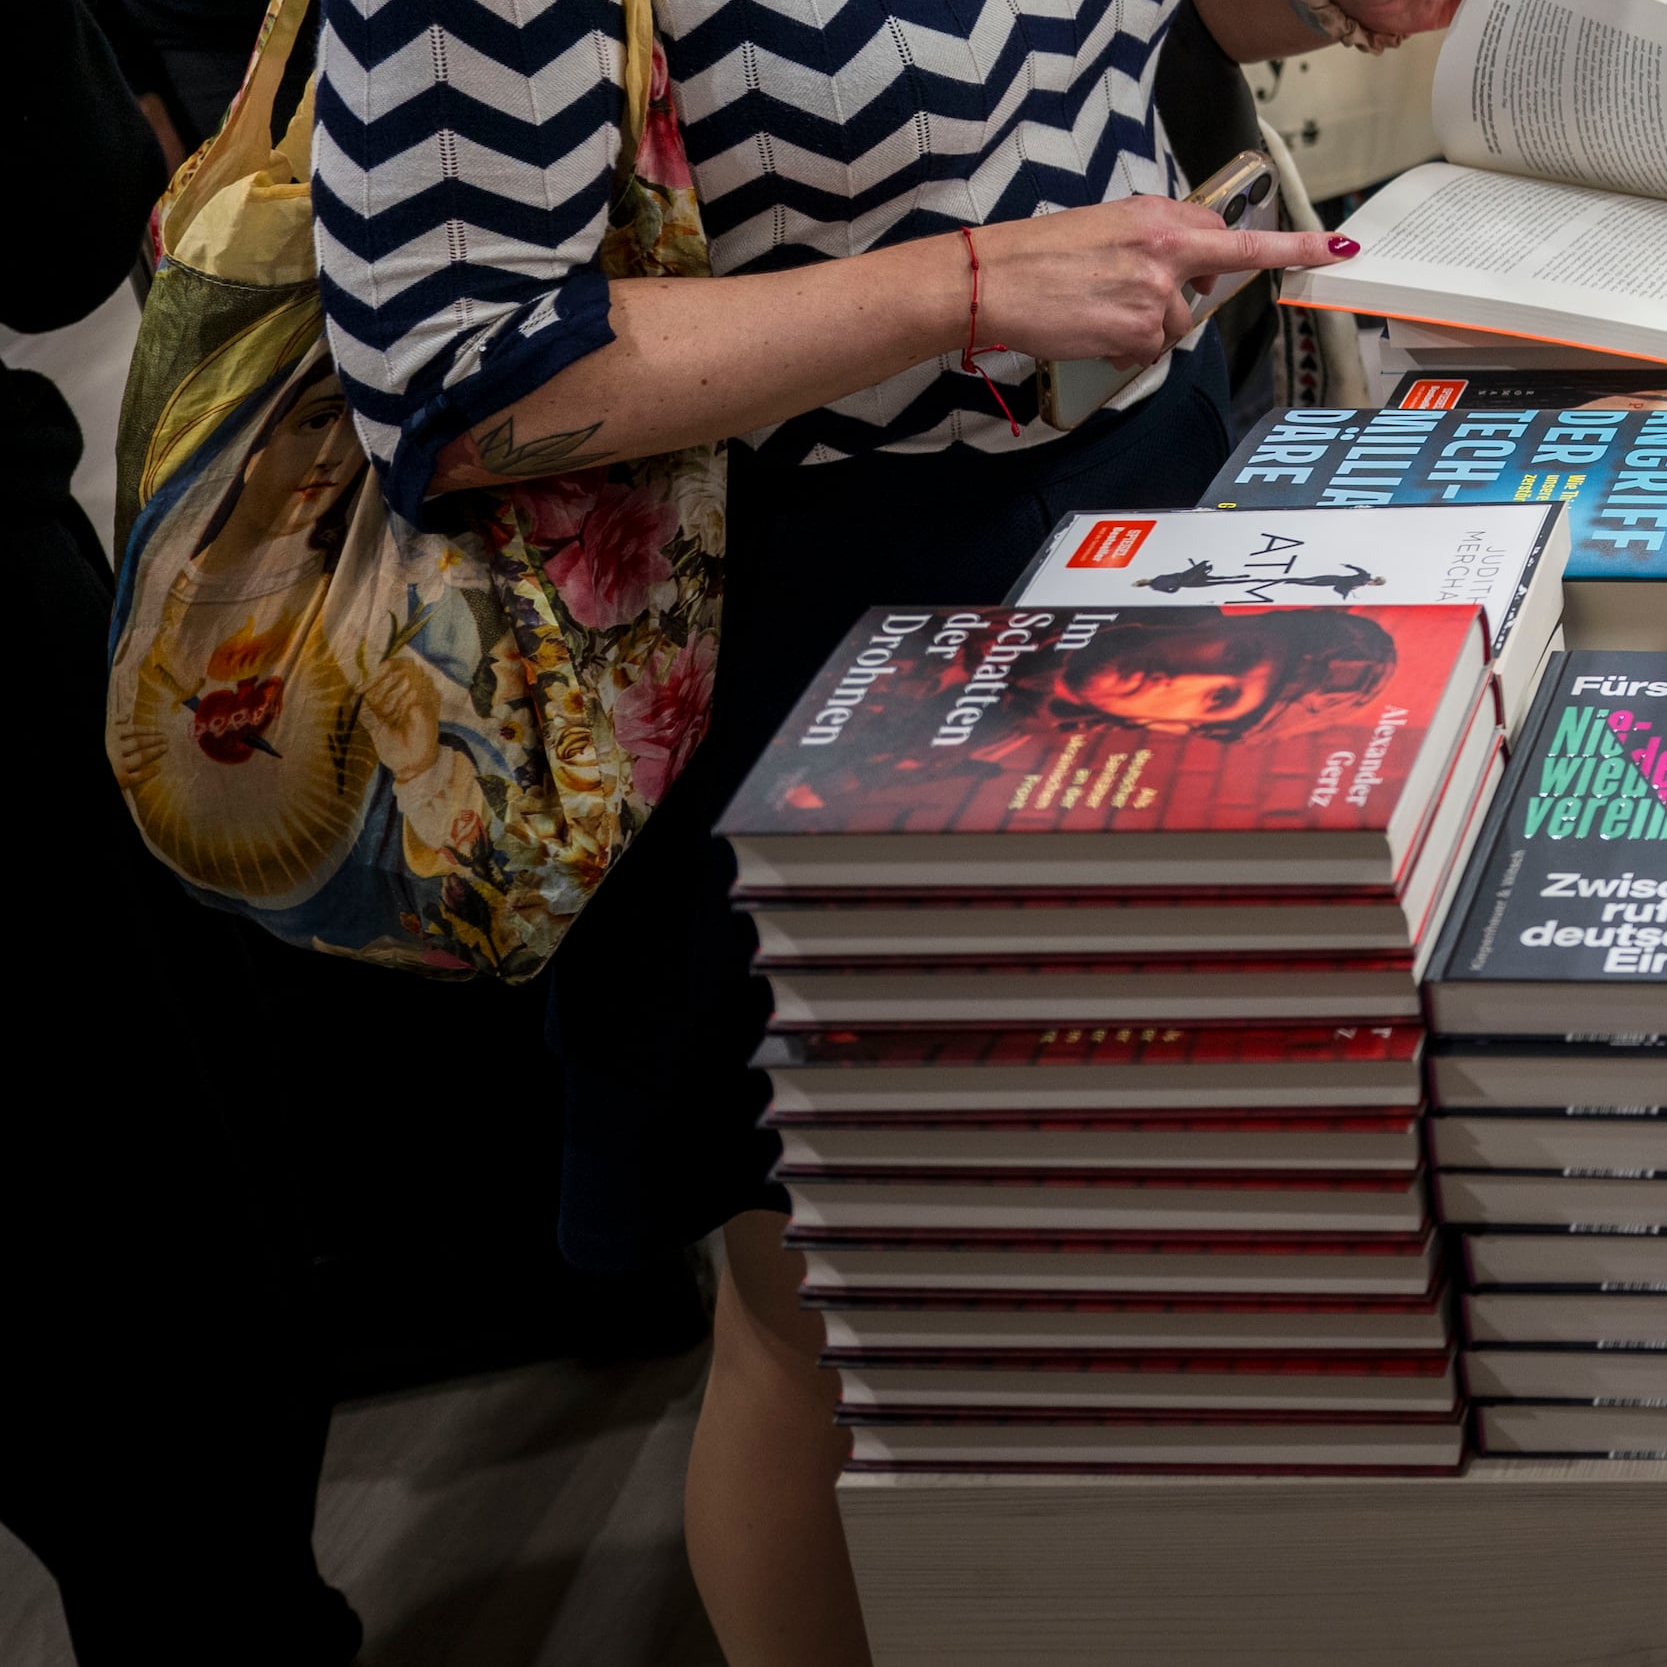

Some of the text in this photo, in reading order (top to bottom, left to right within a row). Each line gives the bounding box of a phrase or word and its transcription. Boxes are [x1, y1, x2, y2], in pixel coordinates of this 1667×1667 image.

[1234, 409, 1358, 485] DÄRE
[1427, 409, 1541, 500] TECH-
[1530, 410, 1630, 465] DER
[1567, 474, 1588, 488] Wie
[925, 613, 990, 661] der
[1054, 613, 1120, 651] Im
[800, 613, 933, 748] Drohnen
[930, 612, 1057, 749] Schatten
[1309, 750, 1356, 808] Gertz
[1346, 704, 1410, 808] Alexander
